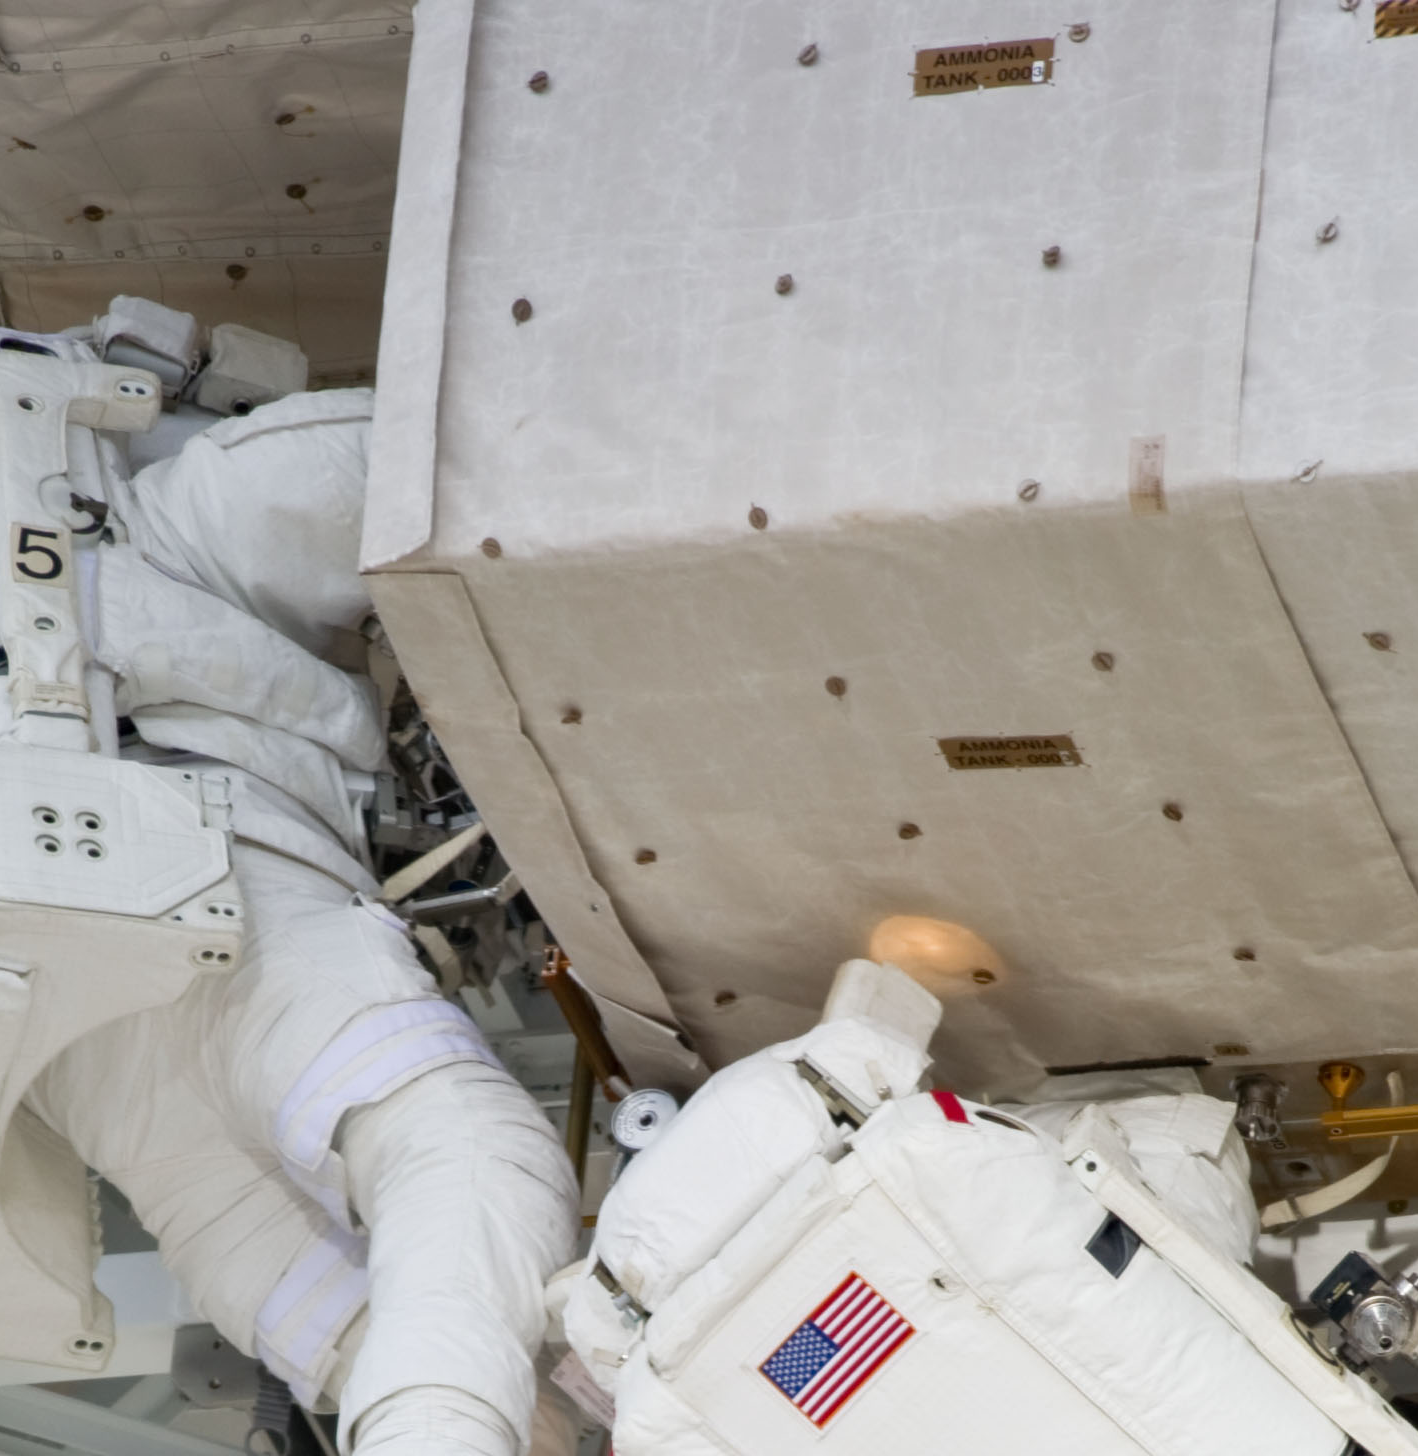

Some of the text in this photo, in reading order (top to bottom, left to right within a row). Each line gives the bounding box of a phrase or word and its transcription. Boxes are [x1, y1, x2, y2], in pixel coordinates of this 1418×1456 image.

[933, 44, 1035, 68] AMMONIA
[923, 70, 979, 89] TANK
[997, 65, 1044, 83] 0003
[15, 526, 64, 581] 5
[958, 738, 1058, 752] AMMONIA
[952, 754, 1011, 767] TANK
